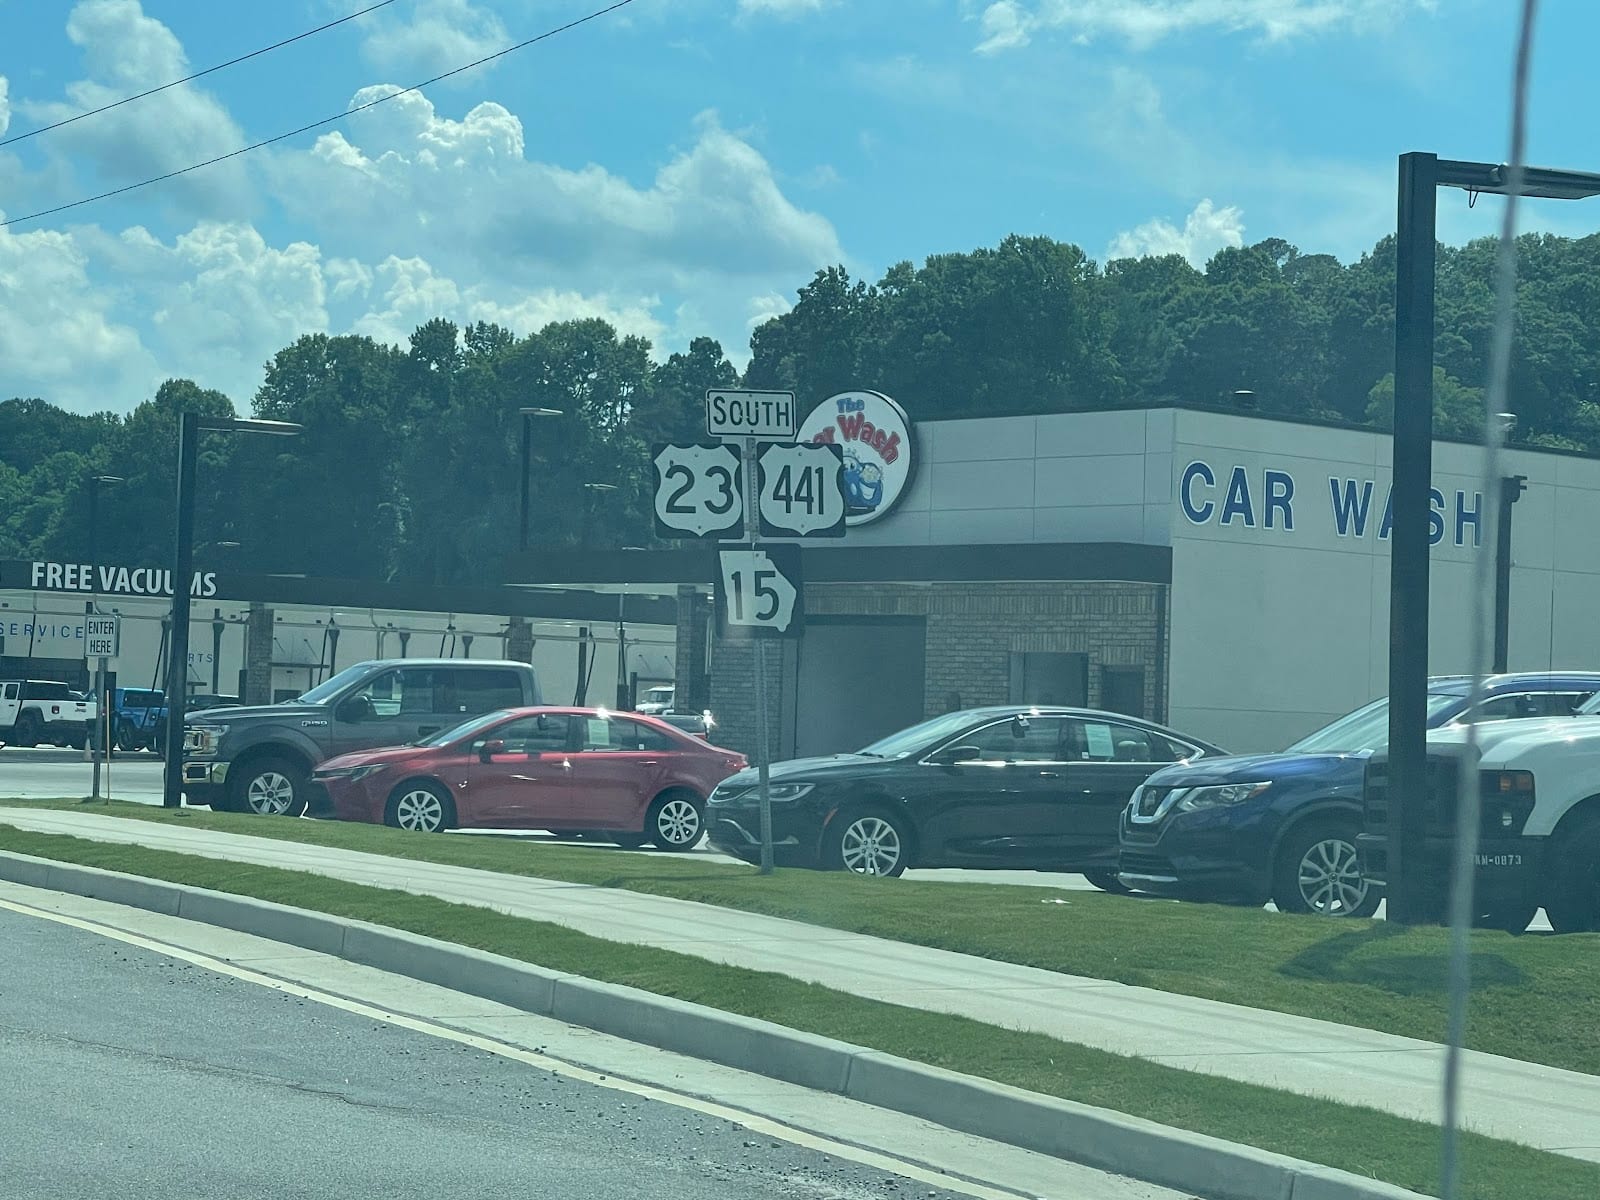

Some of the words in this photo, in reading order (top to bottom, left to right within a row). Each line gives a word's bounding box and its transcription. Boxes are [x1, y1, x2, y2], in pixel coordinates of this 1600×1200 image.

[712, 395, 790, 427] SOUTH
[836, 397, 865, 413] The
[803, 426, 836, 444] ar
[836, 411, 901, 466] Wash
[665, 464, 734, 514] 23
[772, 465, 825, 515] 441
[1179, 459, 1295, 532] CAR
[31, 561, 92, 590] FREE
[730, 570, 780, 621] 15
[0, 622, 84, 639] SERVICE
[88, 621, 114, 635] ENTER
[90, 639, 112, 653] HERE
